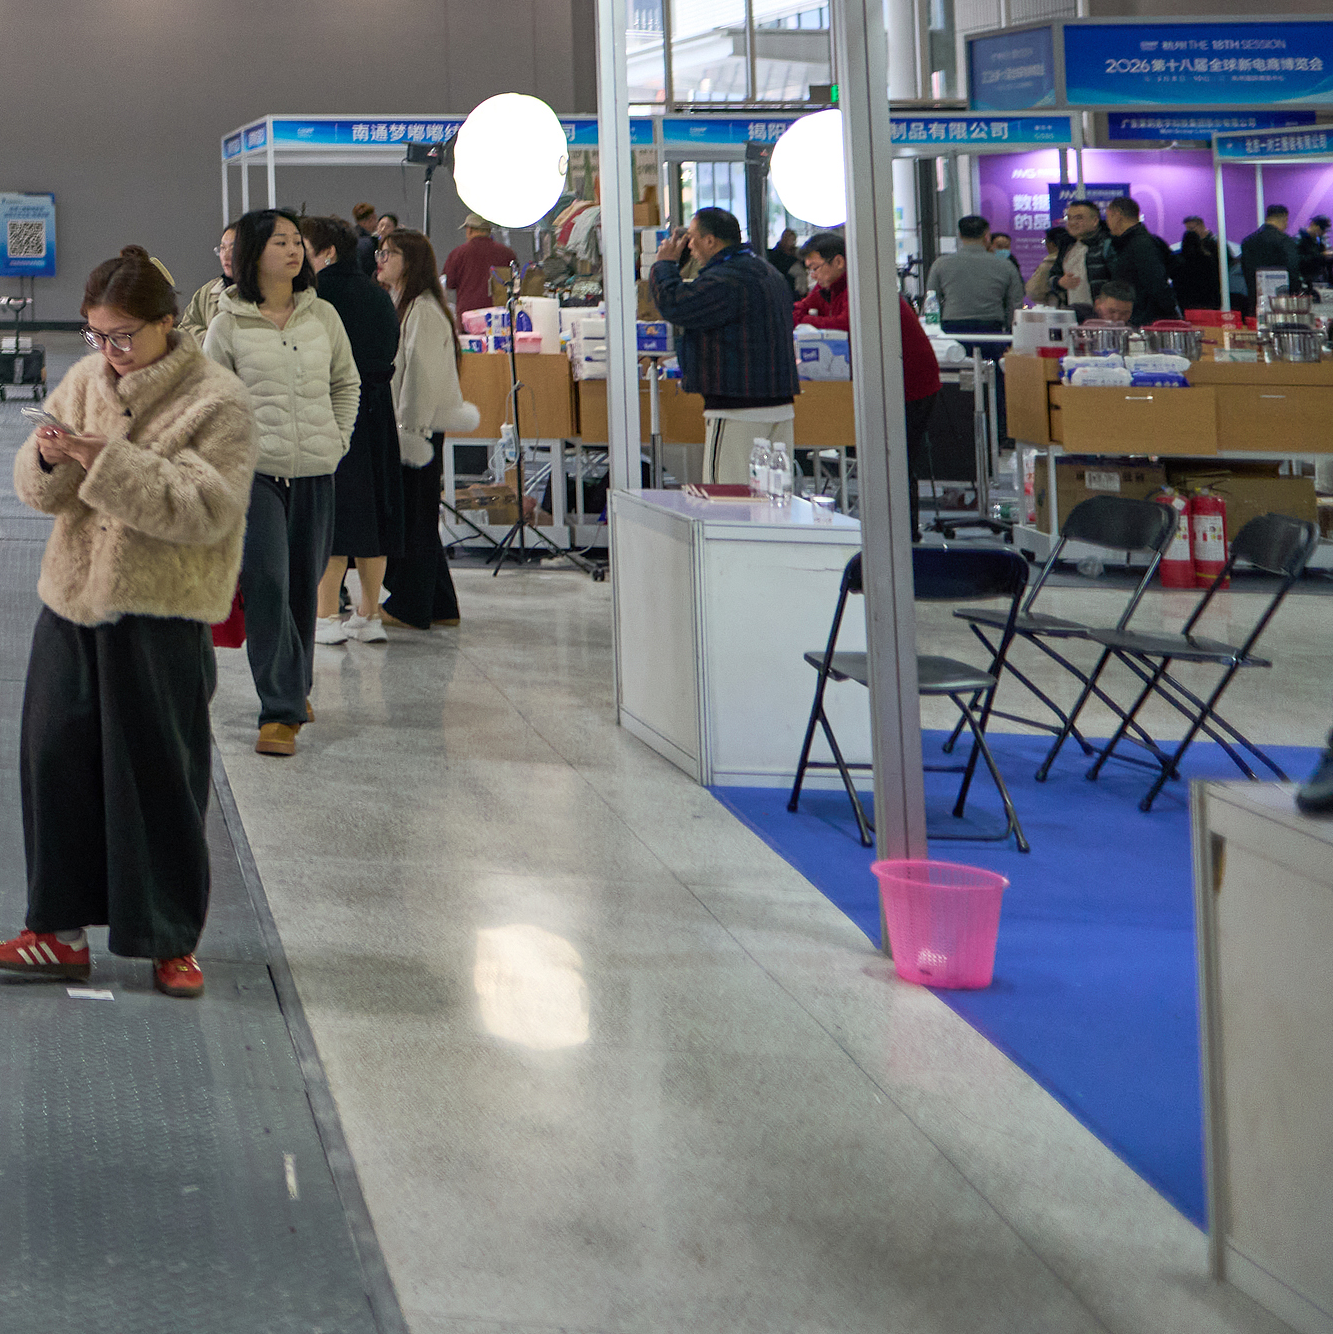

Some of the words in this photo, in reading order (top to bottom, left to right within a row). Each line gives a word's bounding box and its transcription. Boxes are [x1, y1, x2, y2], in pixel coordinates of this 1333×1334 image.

[890, 121, 1009, 141] 制品有限公司
